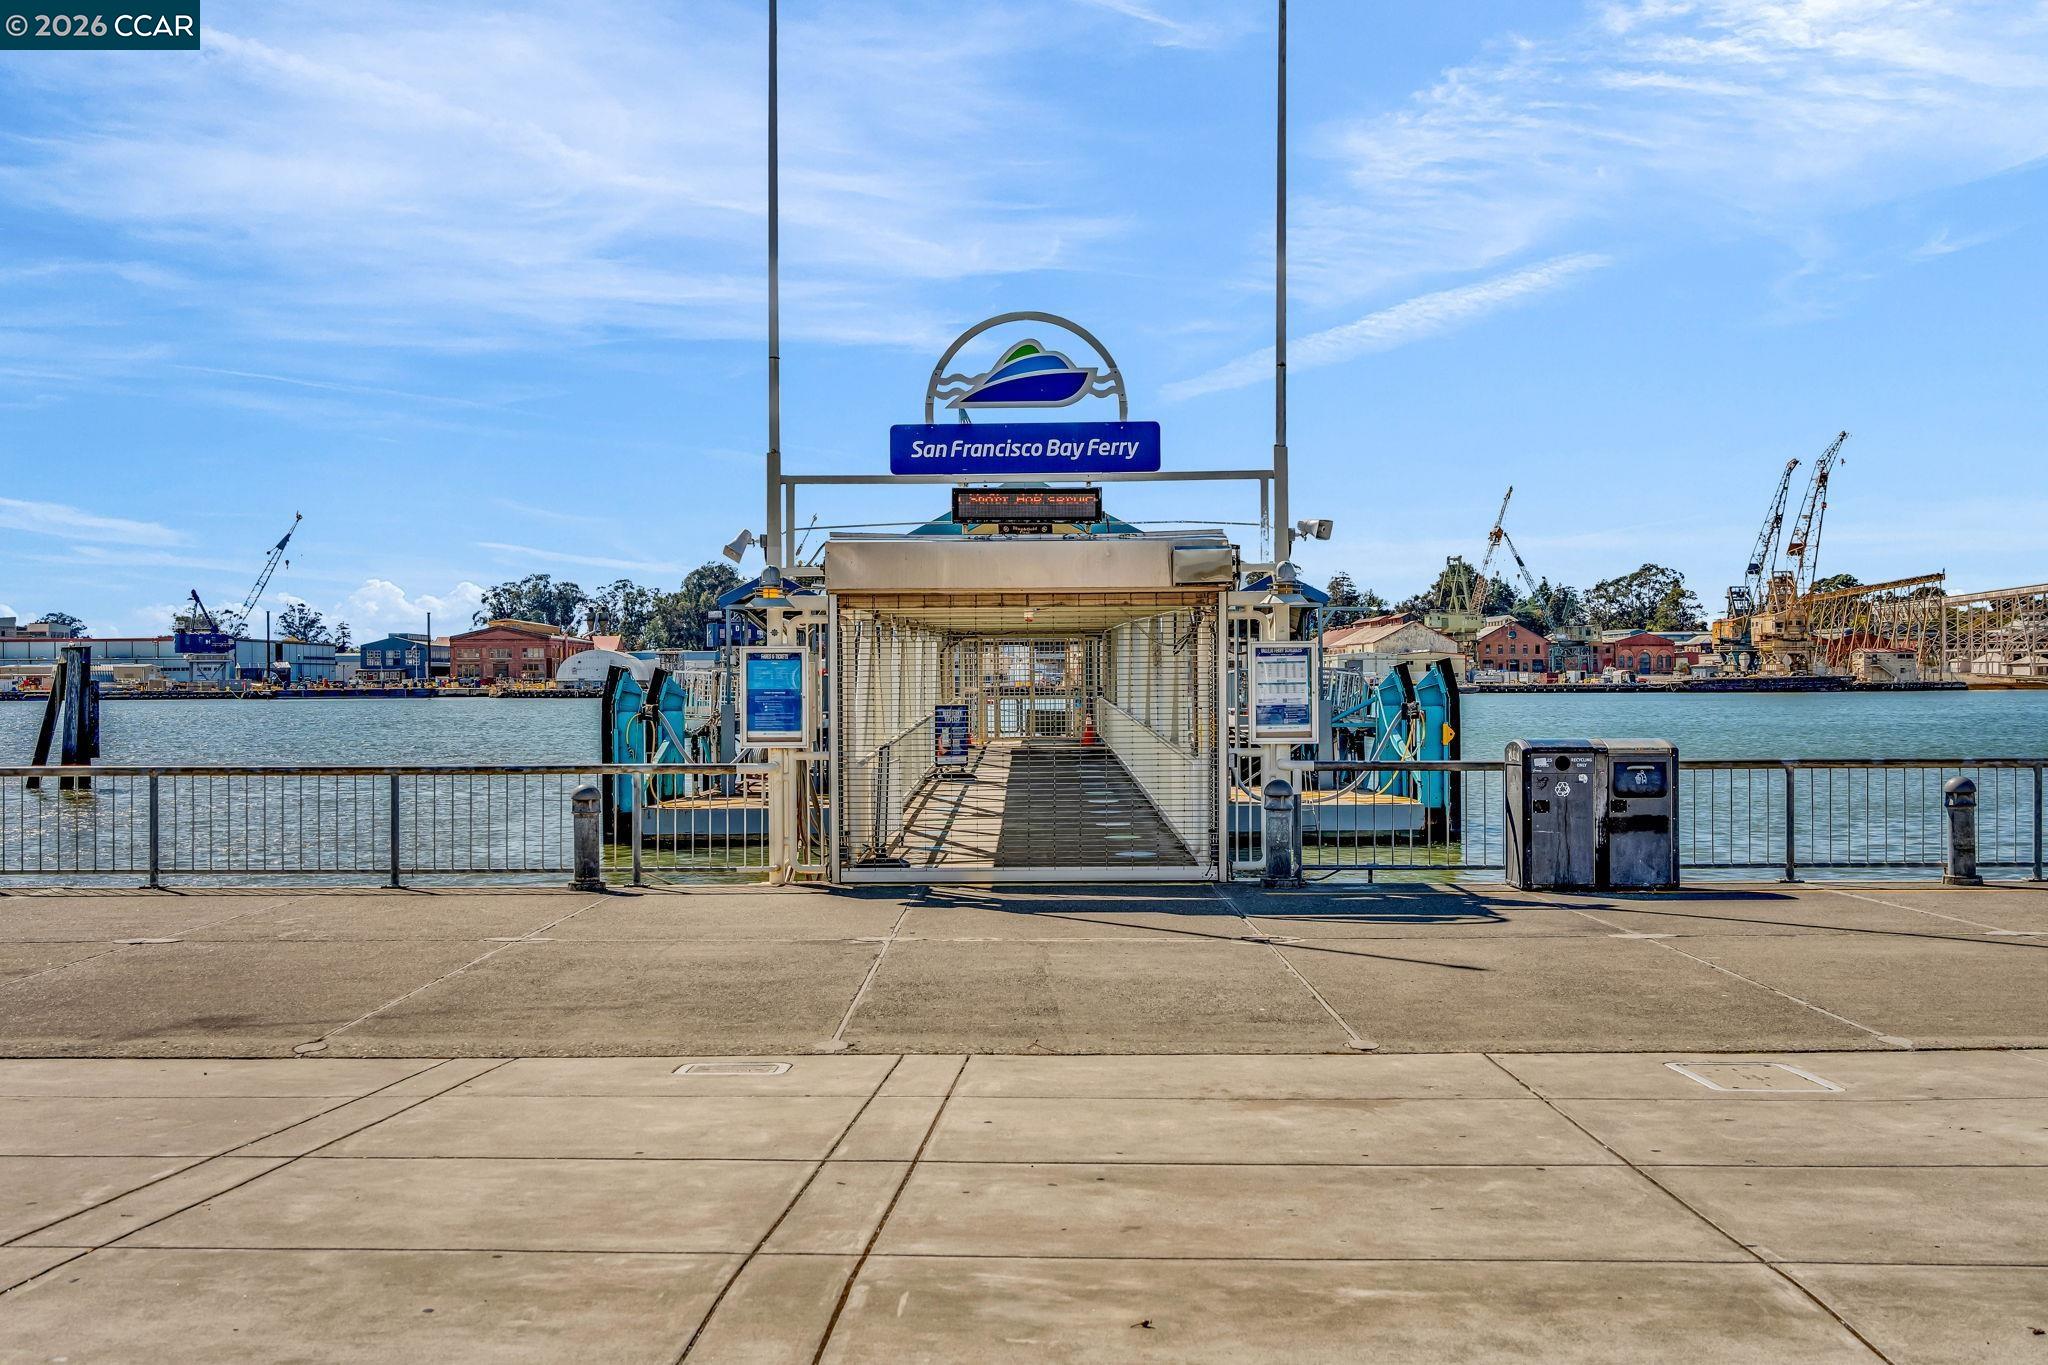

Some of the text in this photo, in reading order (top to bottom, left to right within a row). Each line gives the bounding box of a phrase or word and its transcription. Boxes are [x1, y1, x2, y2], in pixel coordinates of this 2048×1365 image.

[911, 438, 1139, 460] San Francisco Bay Ferry
